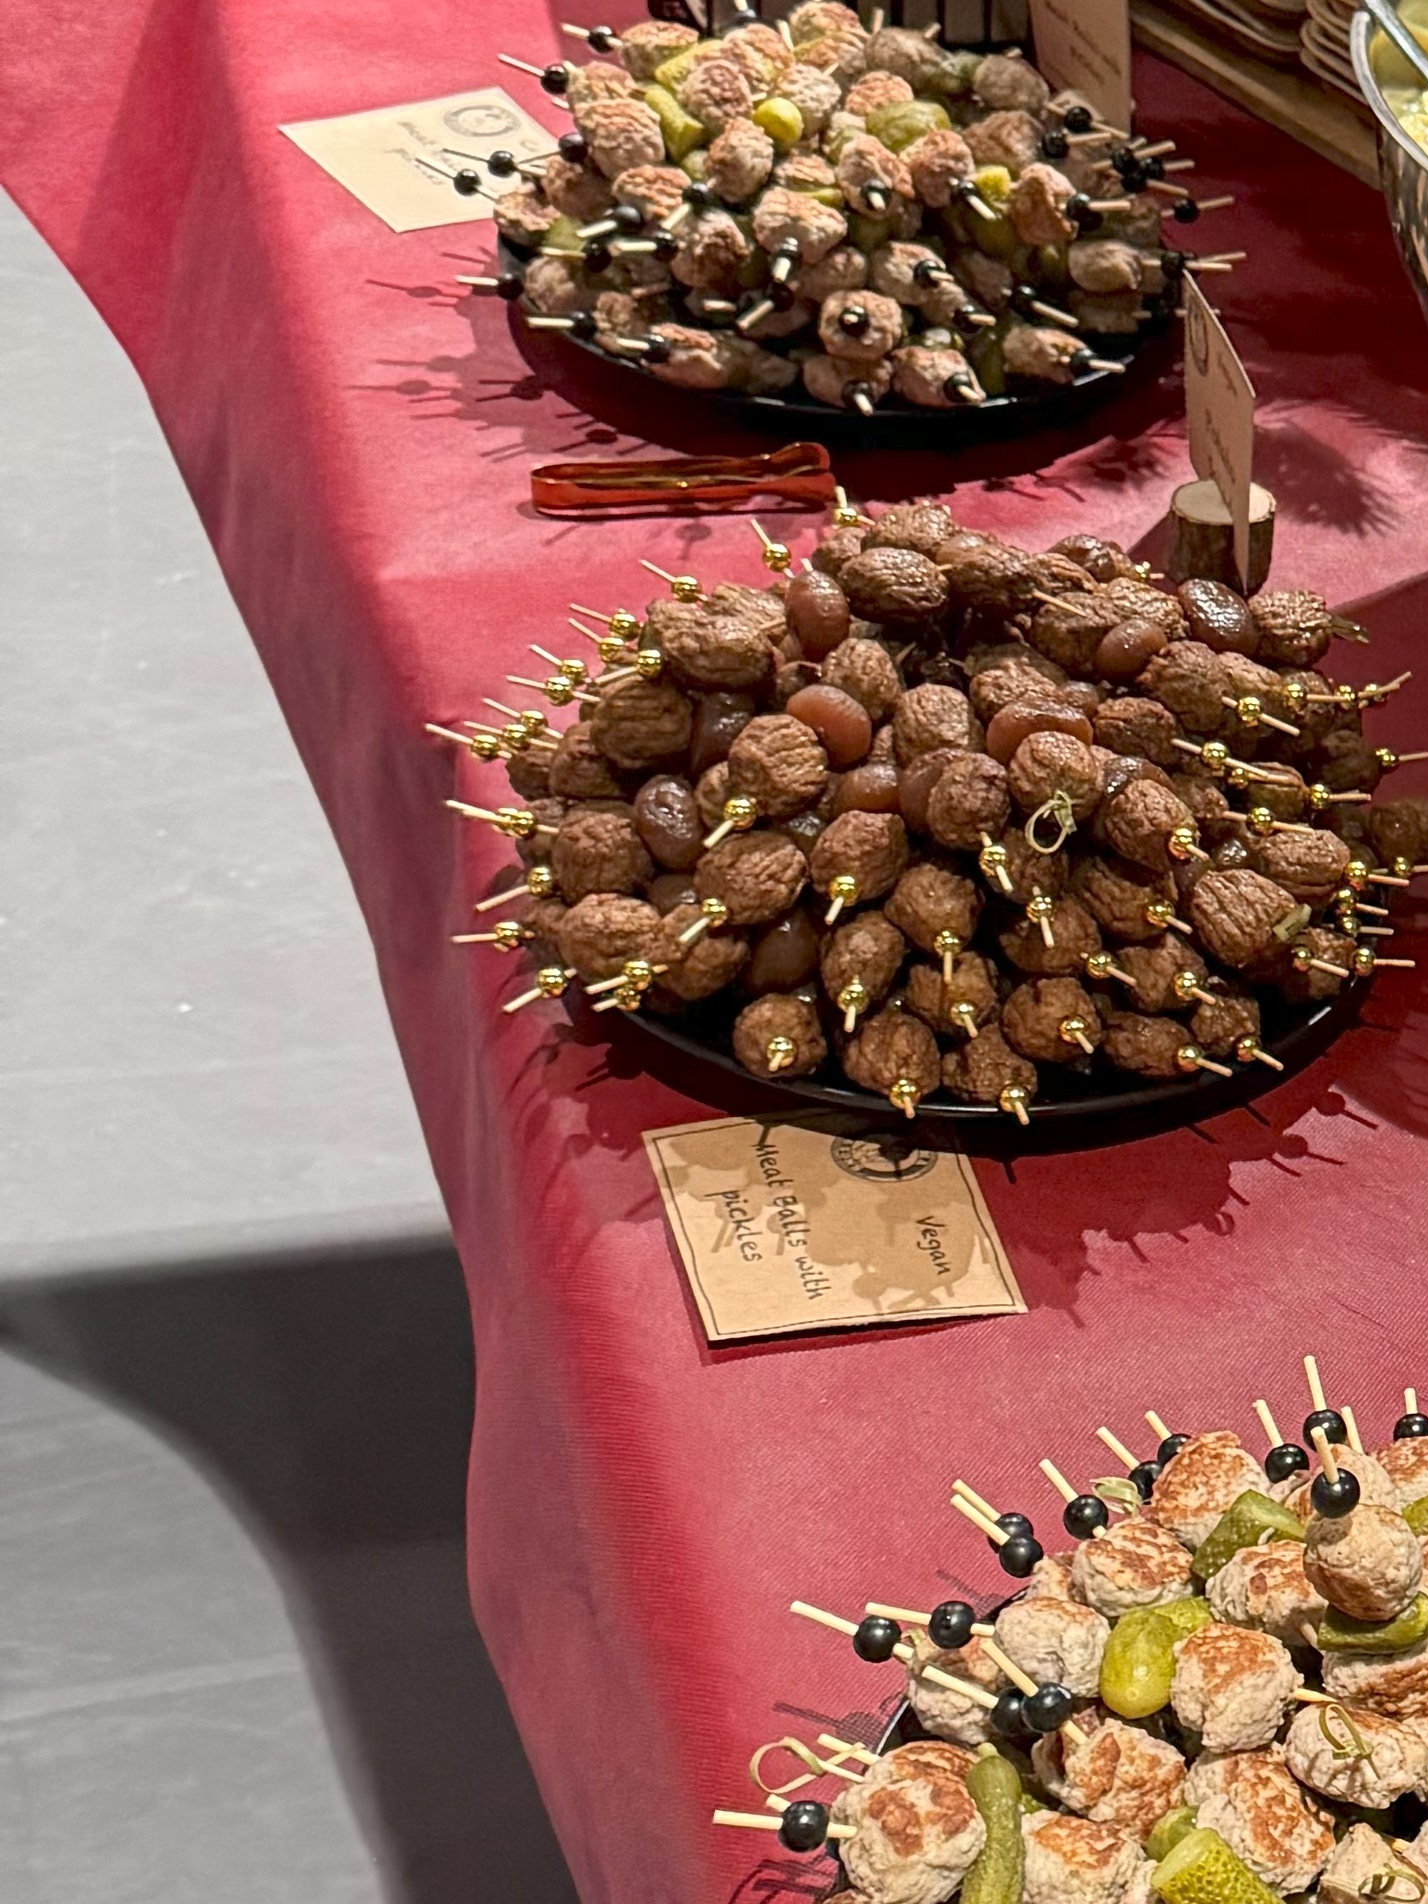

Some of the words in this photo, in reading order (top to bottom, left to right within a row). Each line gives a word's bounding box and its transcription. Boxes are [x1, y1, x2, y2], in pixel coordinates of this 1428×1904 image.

[751, 1143, 786, 1189] Meat
[772, 1195, 811, 1249] Balls
[795, 1256, 834, 1301] with
[914, 1215, 952, 1276] Vegan
